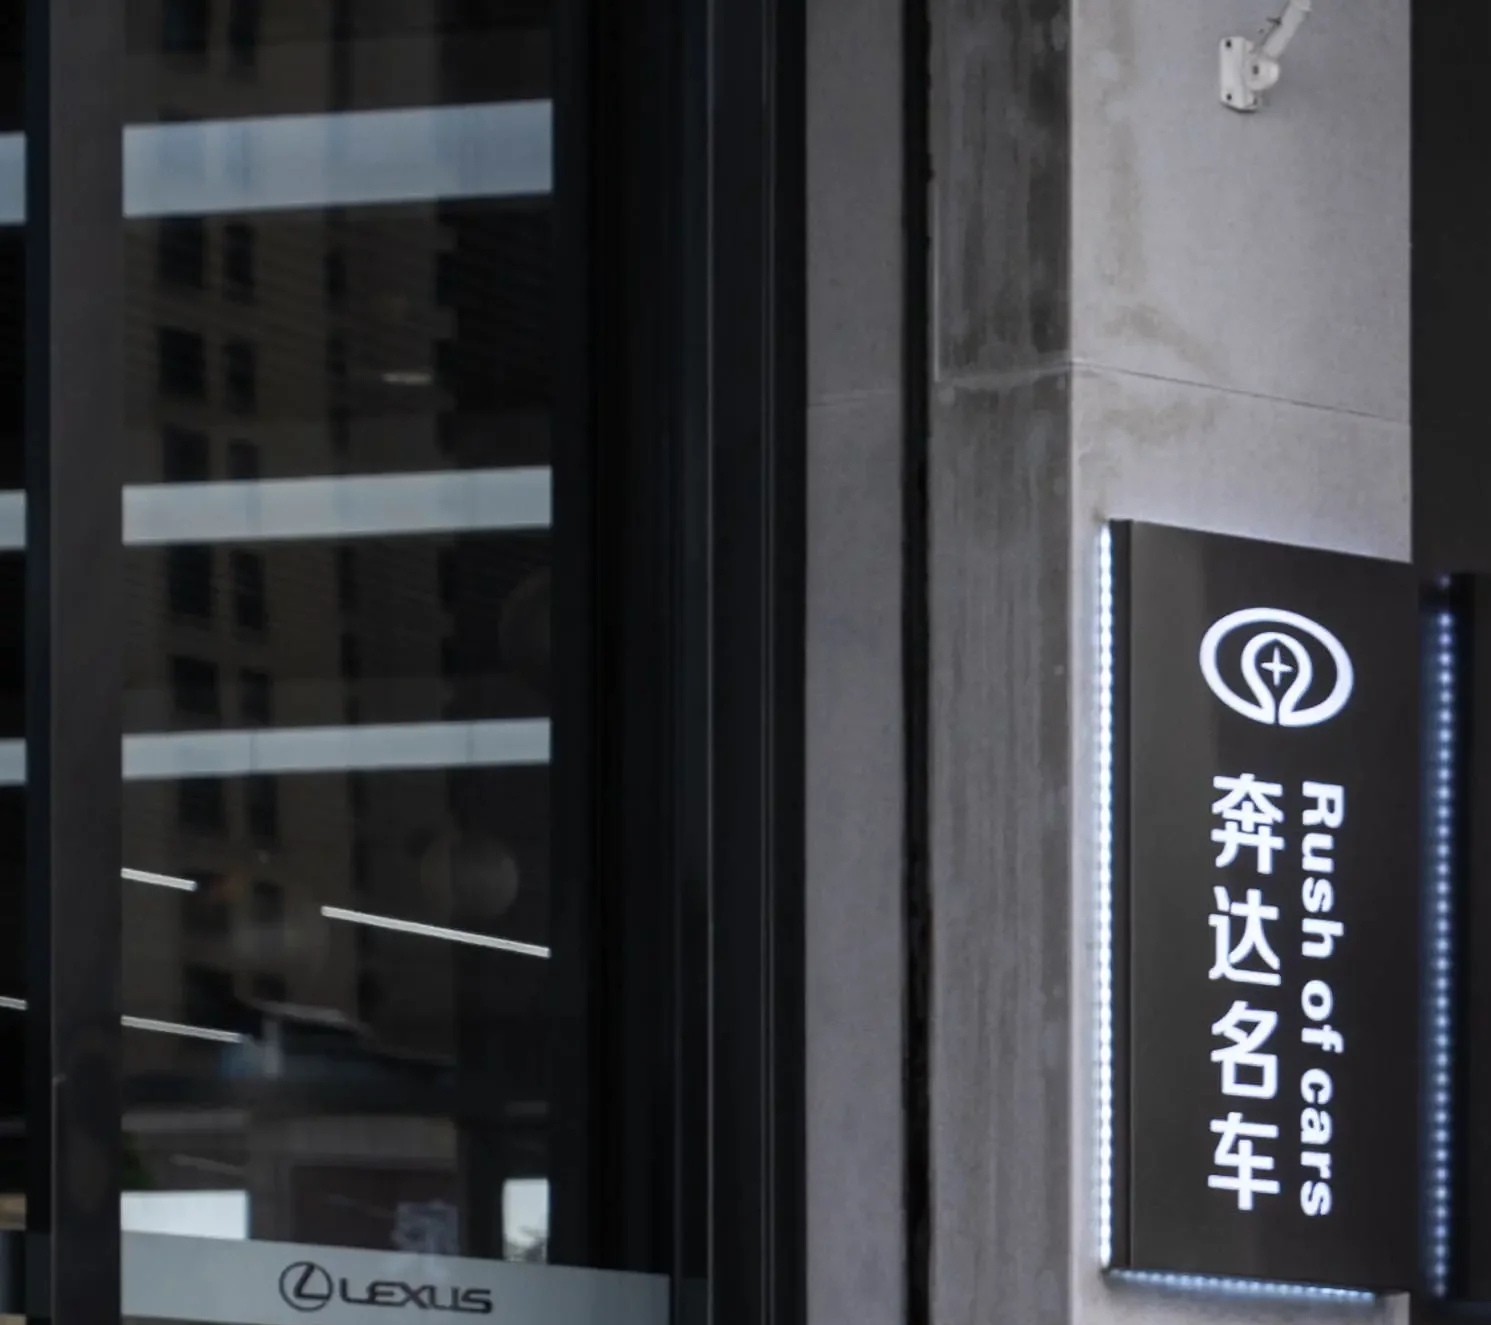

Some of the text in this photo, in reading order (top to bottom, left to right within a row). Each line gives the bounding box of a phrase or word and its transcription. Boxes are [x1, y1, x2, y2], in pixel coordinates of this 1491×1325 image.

[1207, 772, 1286, 1212] 奔达名车
[1299, 780, 1345, 1217] Rush of cars
[339, 1277, 494, 1314] LEXUS
